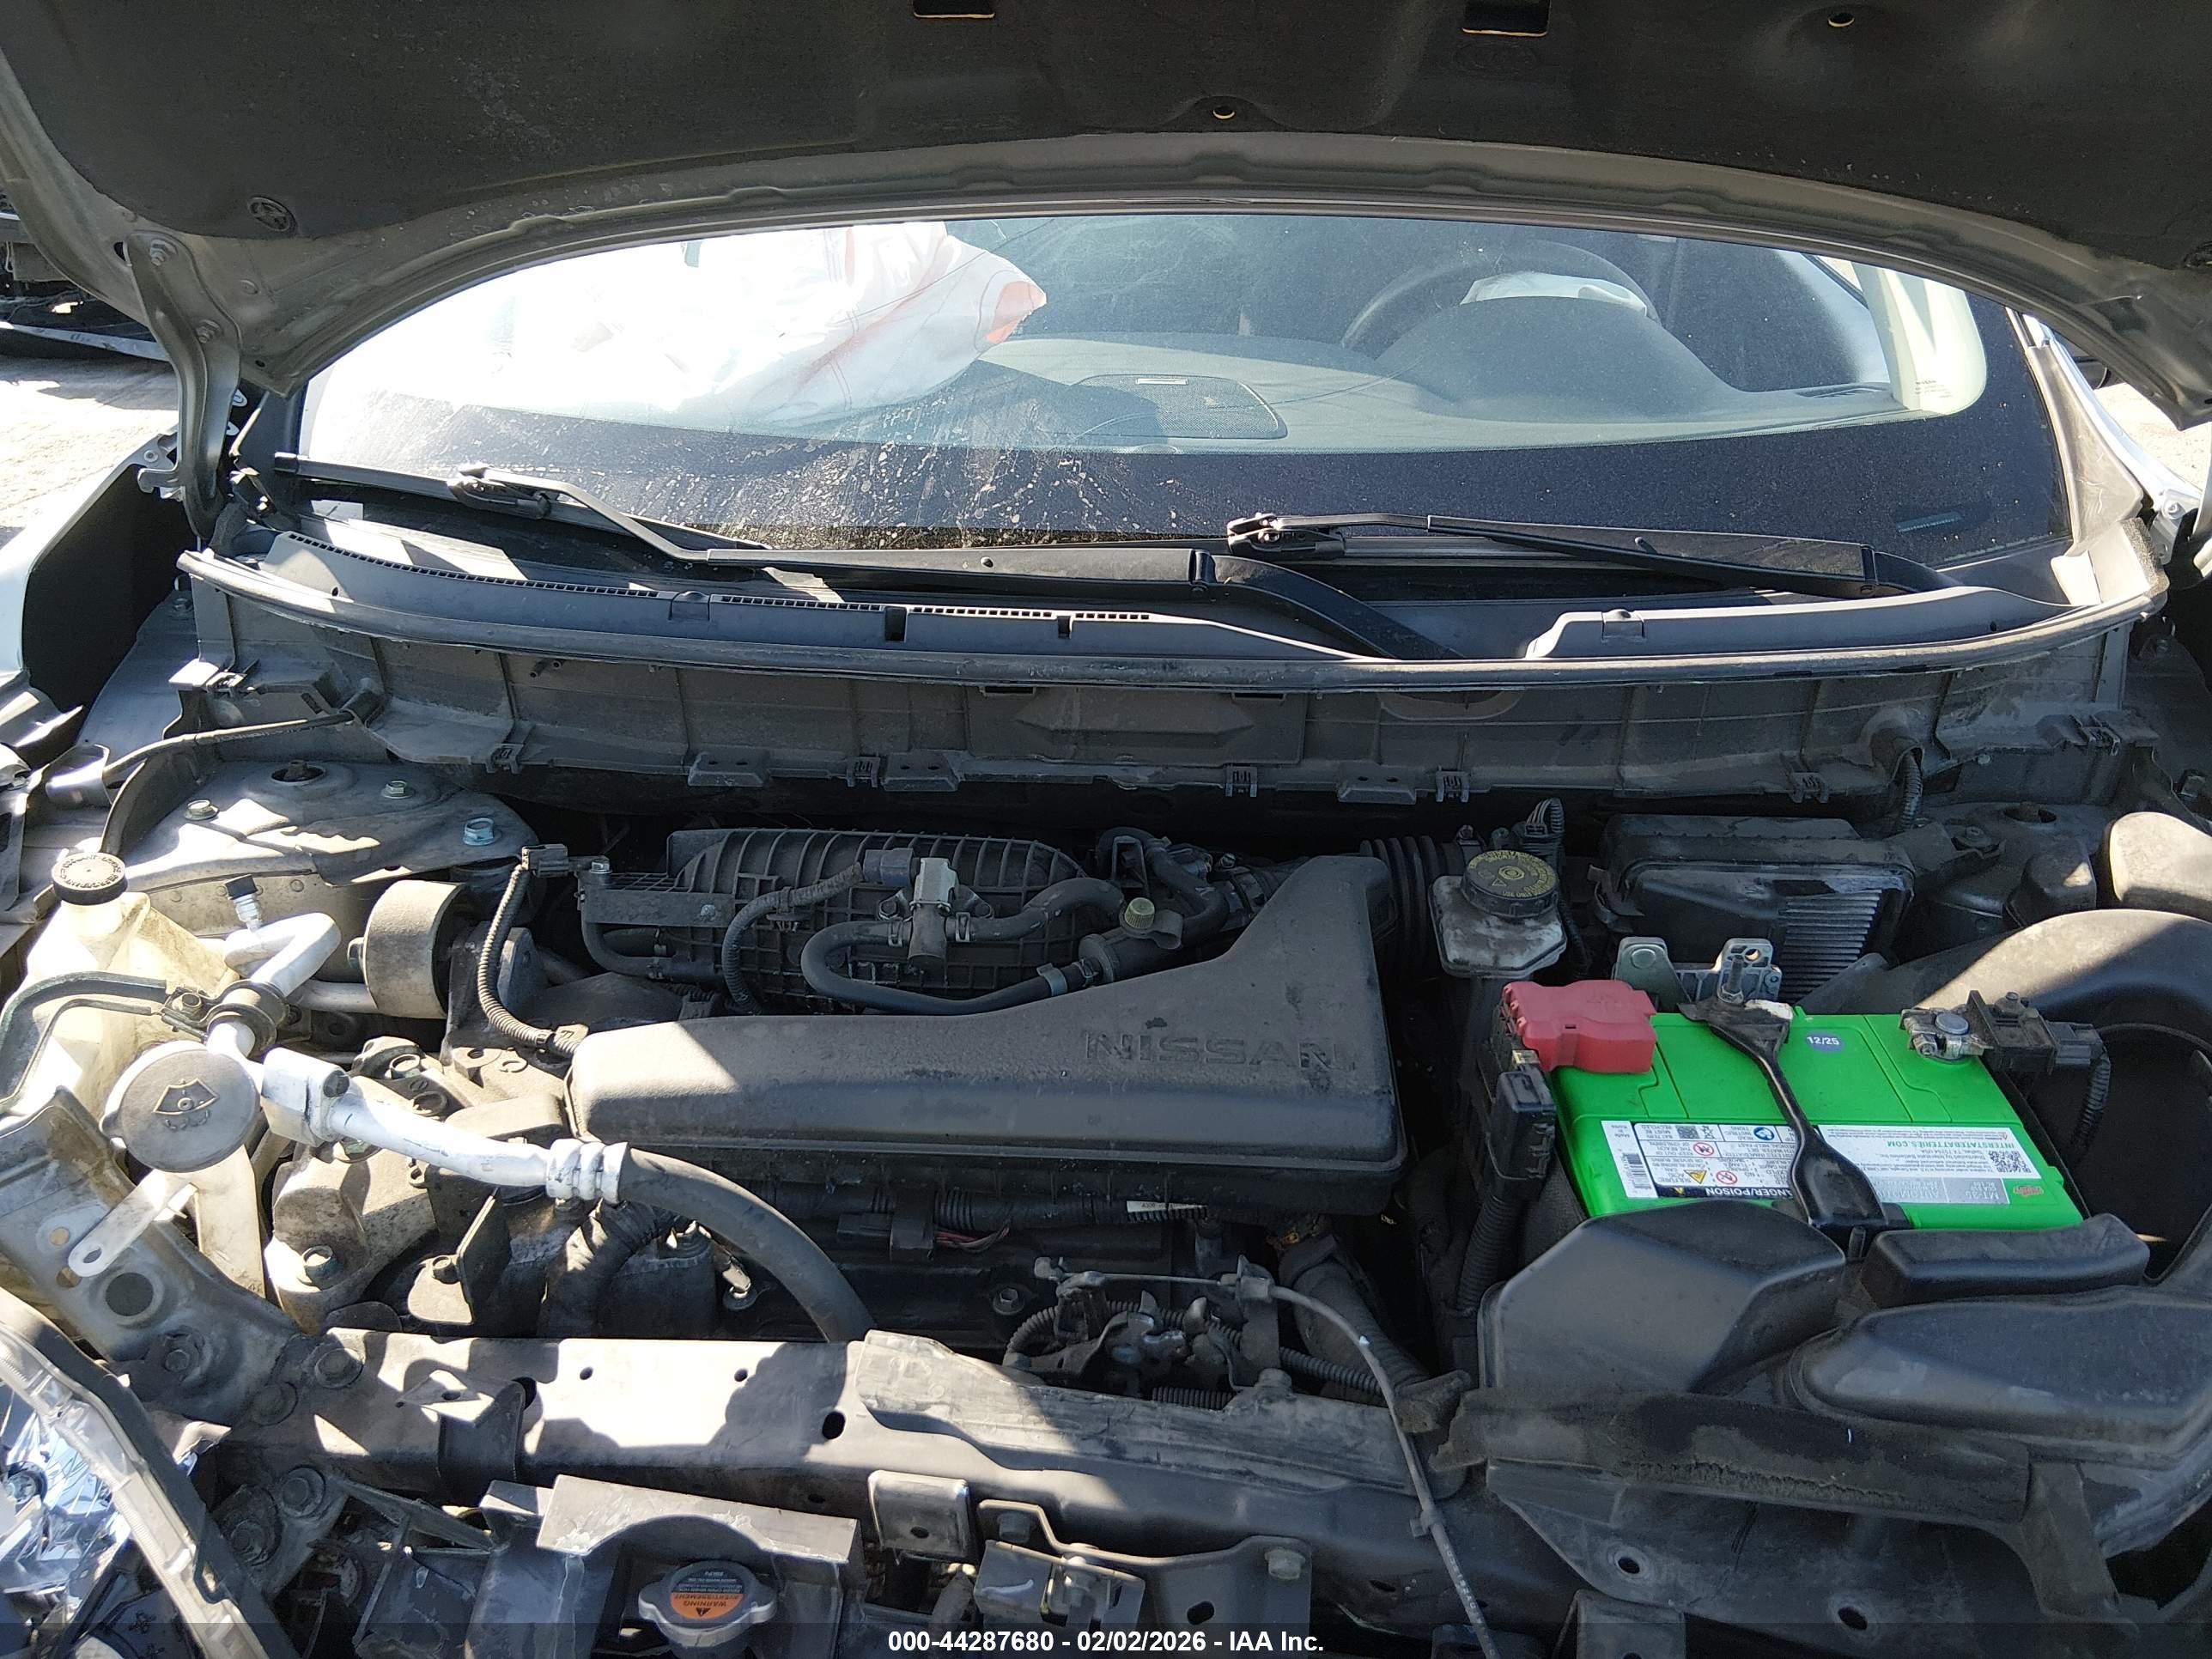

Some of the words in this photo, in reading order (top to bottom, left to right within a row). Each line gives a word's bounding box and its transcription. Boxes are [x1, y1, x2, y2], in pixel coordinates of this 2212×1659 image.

[1806, 1036, 1840, 1045] 12/25
[1085, 1031, 1355, 1071] NISSAN
[1887, 1140, 2014, 1149] INTERSTATEBATTERIES.COM
[1705, 1188, 1792, 1196] ANGER/POISON
